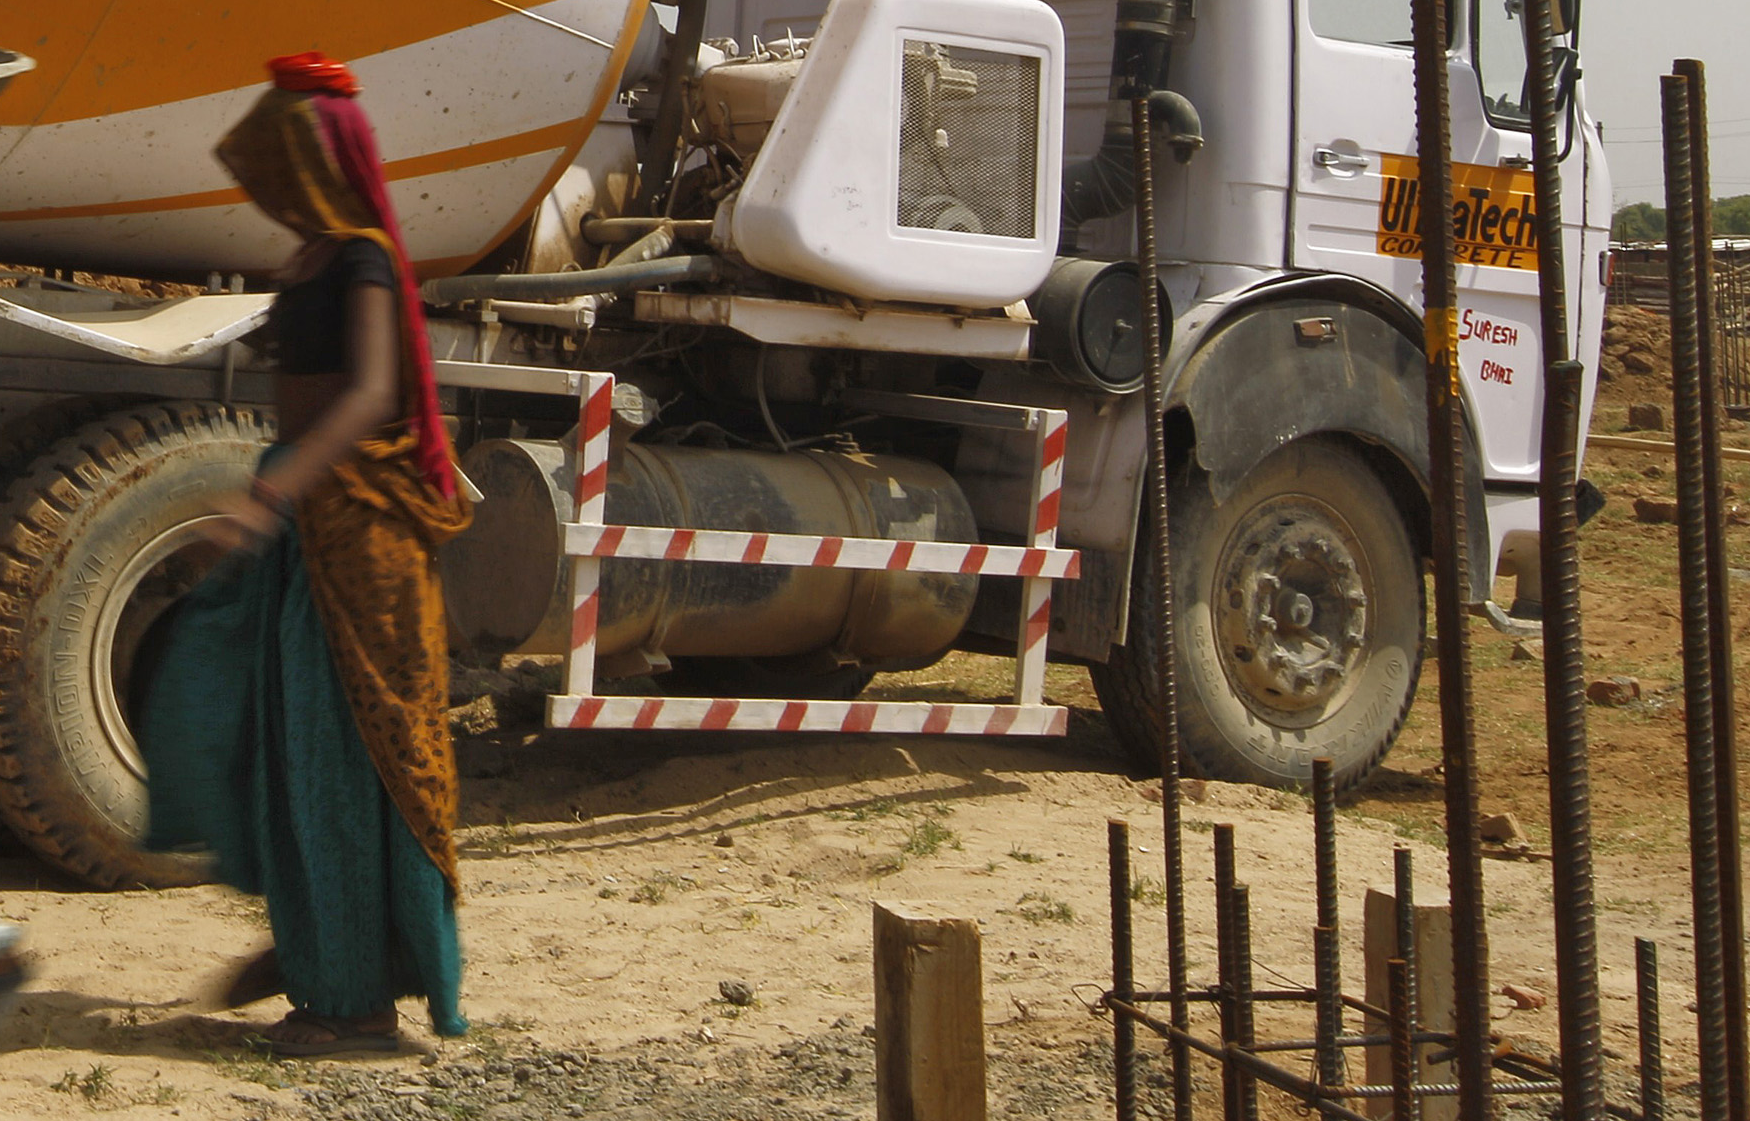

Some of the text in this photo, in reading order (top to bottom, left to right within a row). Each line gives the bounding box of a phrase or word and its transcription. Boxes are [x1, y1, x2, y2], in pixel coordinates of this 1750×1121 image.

[1381, 177, 1539, 250] UlaTech
[1380, 235, 1525, 269] CORETE
[1458, 308, 1518, 347] SURESH
